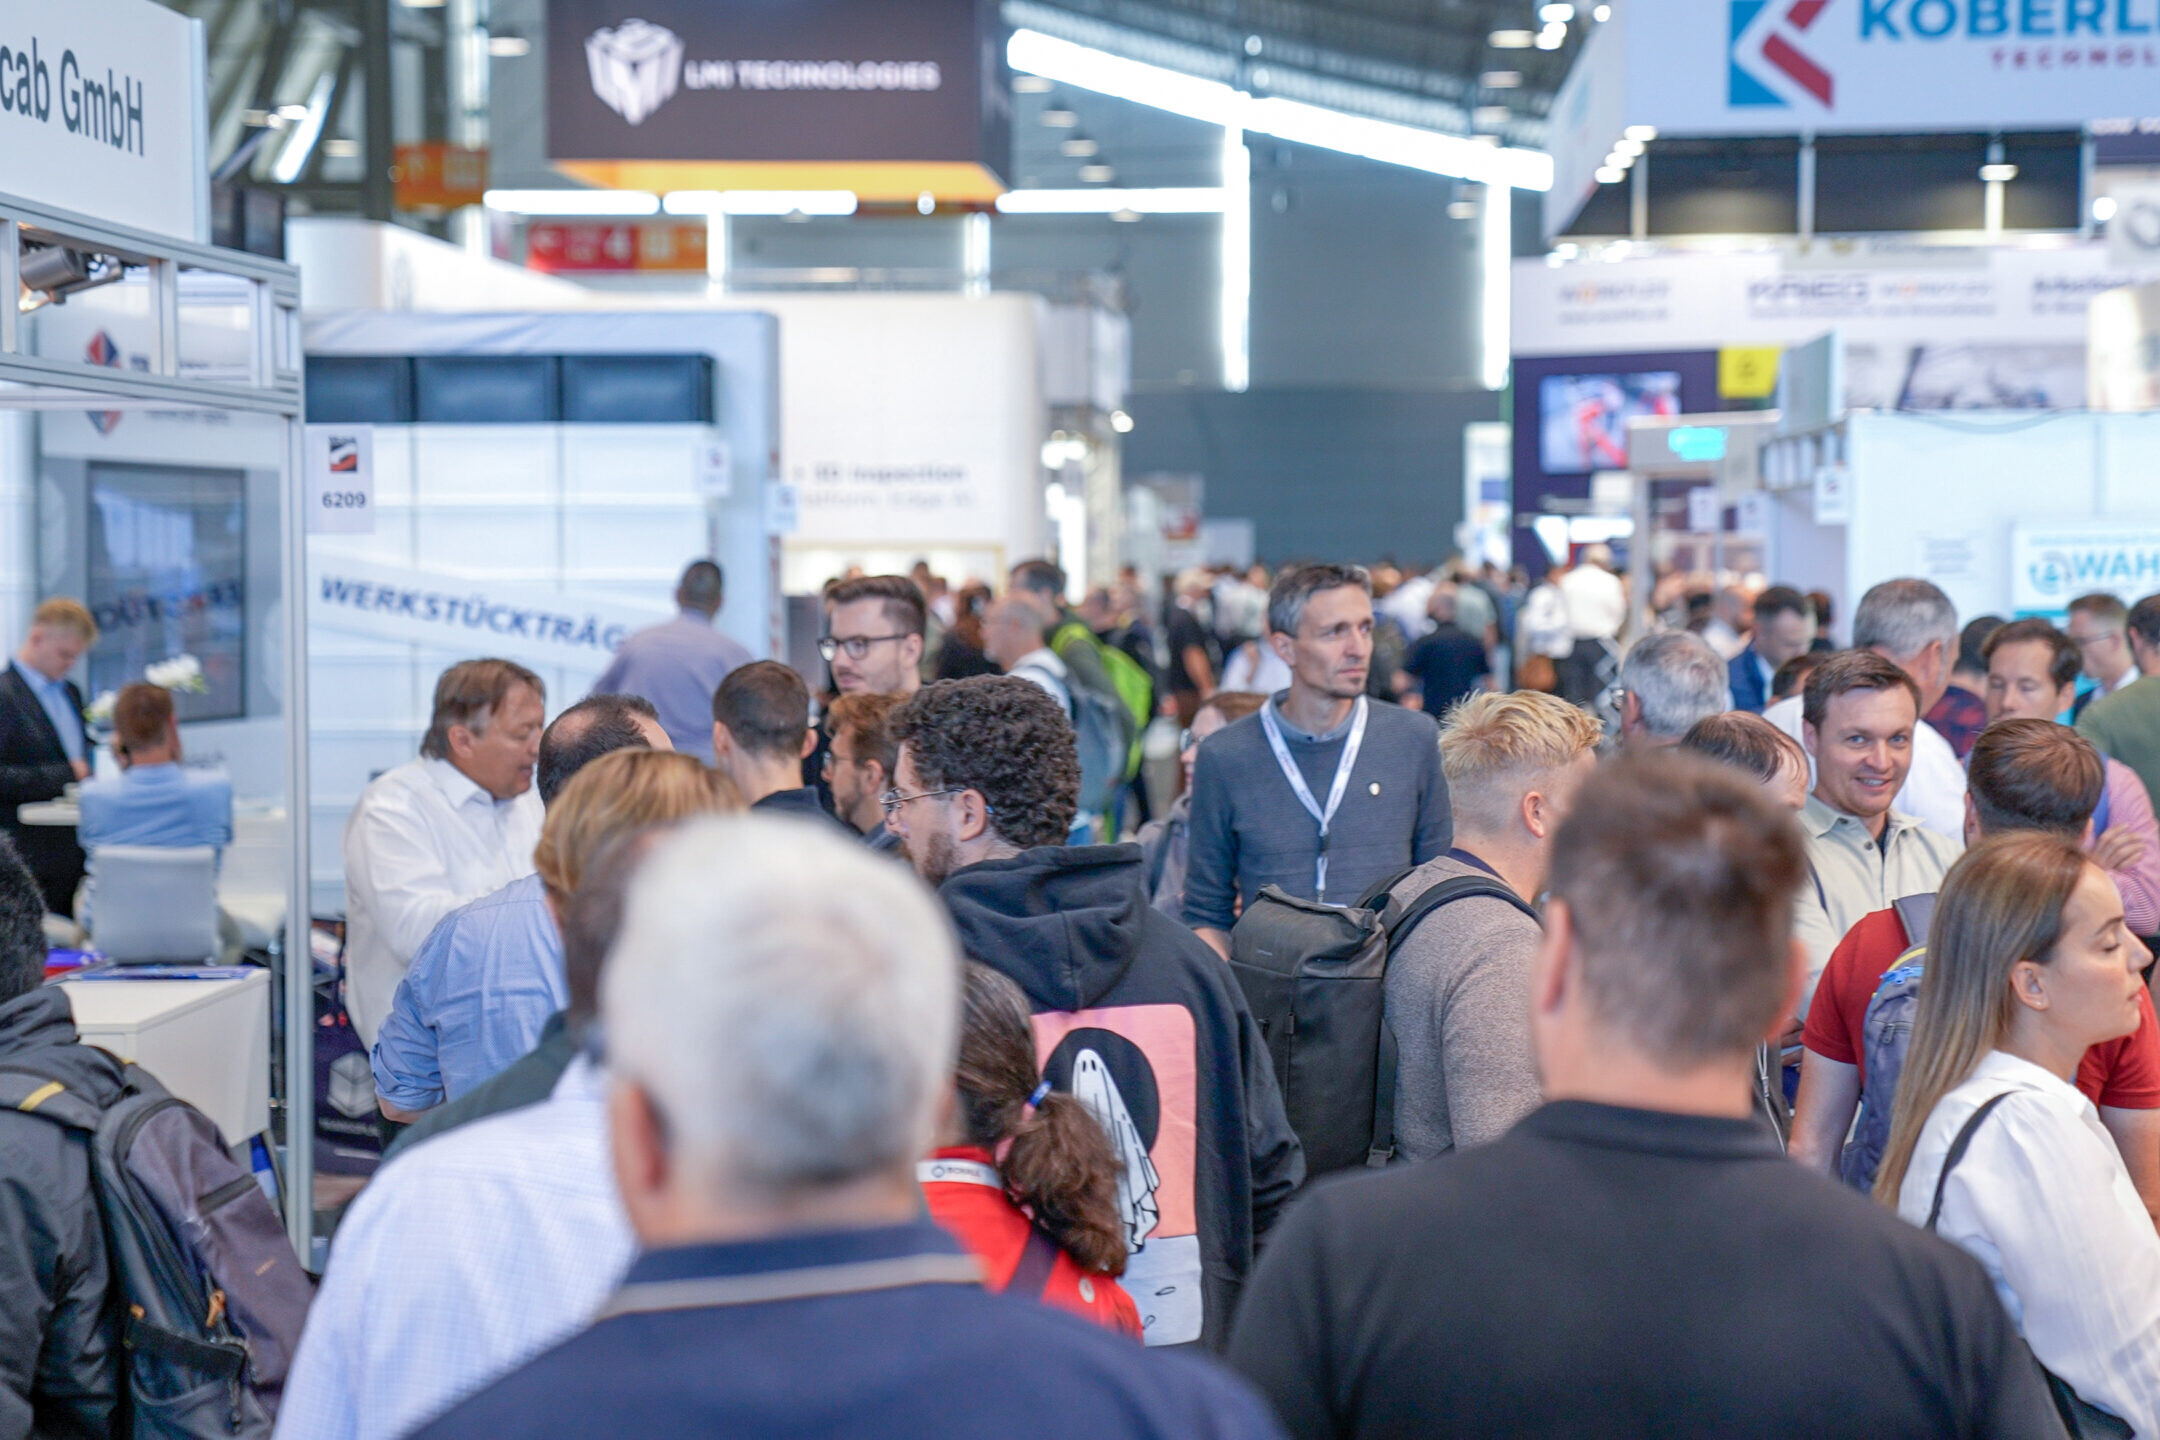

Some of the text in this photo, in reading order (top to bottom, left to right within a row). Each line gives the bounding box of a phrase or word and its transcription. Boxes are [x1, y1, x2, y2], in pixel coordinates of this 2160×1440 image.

[1861, 0, 2160, 39] KOBERL
[684, 60, 942, 91] LMI TECHNOLOGIES
[0, 36, 143, 156] cab GmbH
[322, 491, 366, 508] 6209
